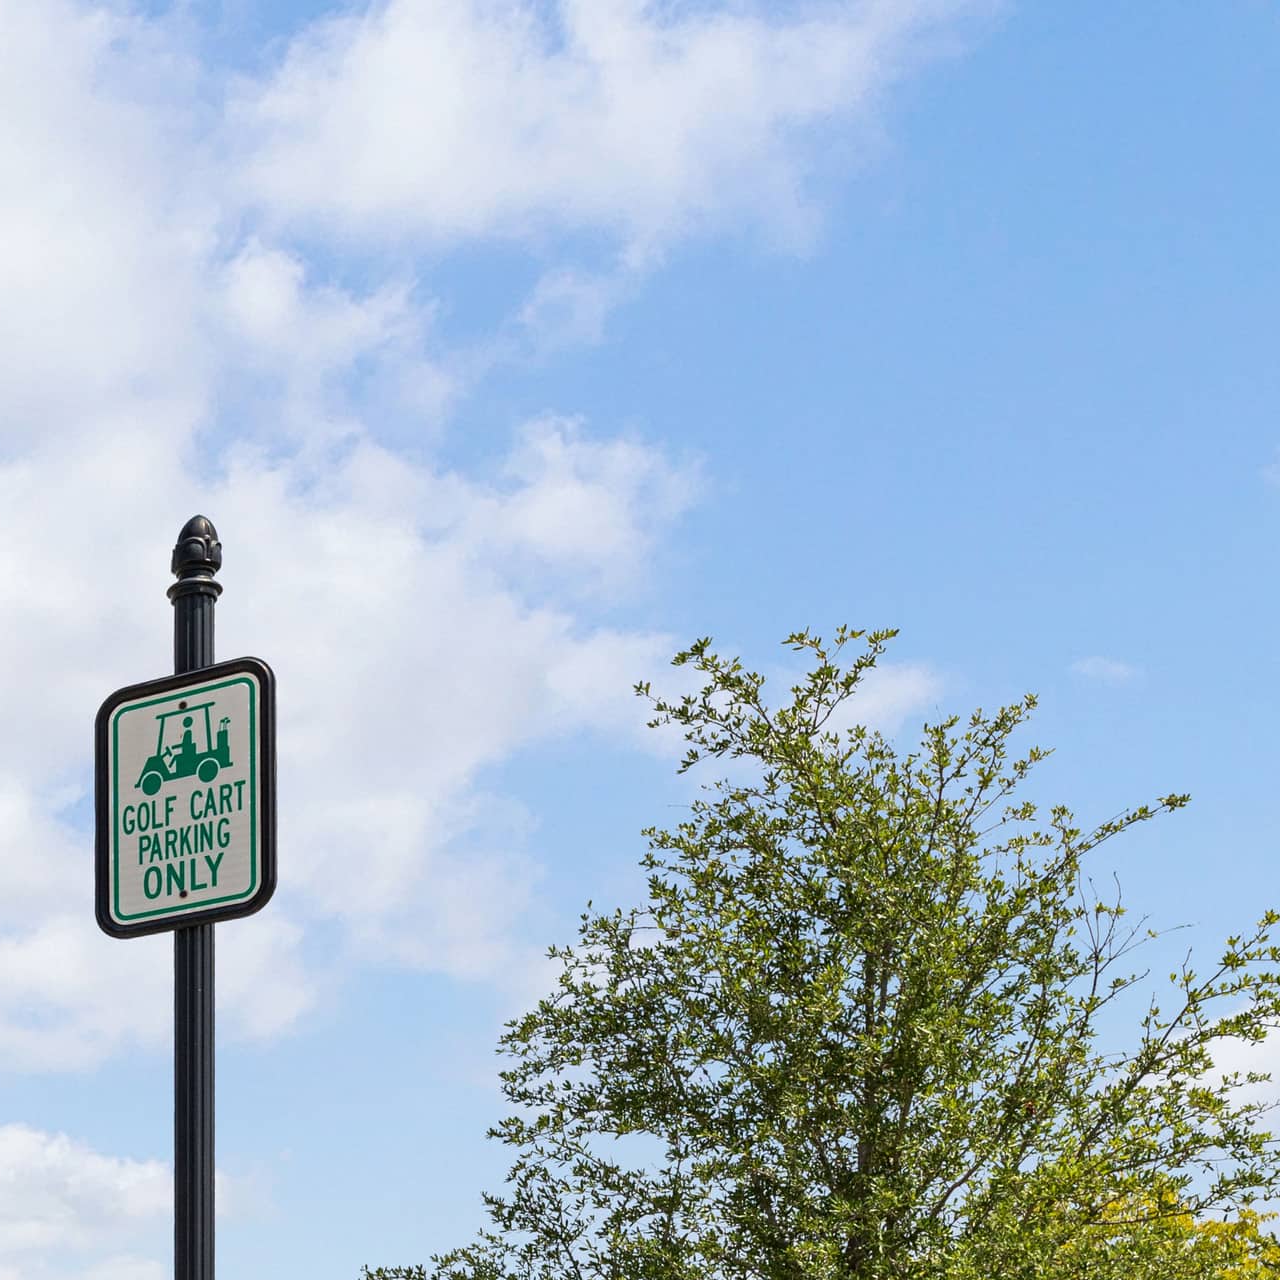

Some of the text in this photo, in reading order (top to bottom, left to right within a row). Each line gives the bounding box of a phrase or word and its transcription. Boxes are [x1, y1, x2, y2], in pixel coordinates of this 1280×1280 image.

[122, 780, 246, 835] GOLF CART
[138, 818, 230, 865] PARKING
[143, 852, 224, 900] ONLY
